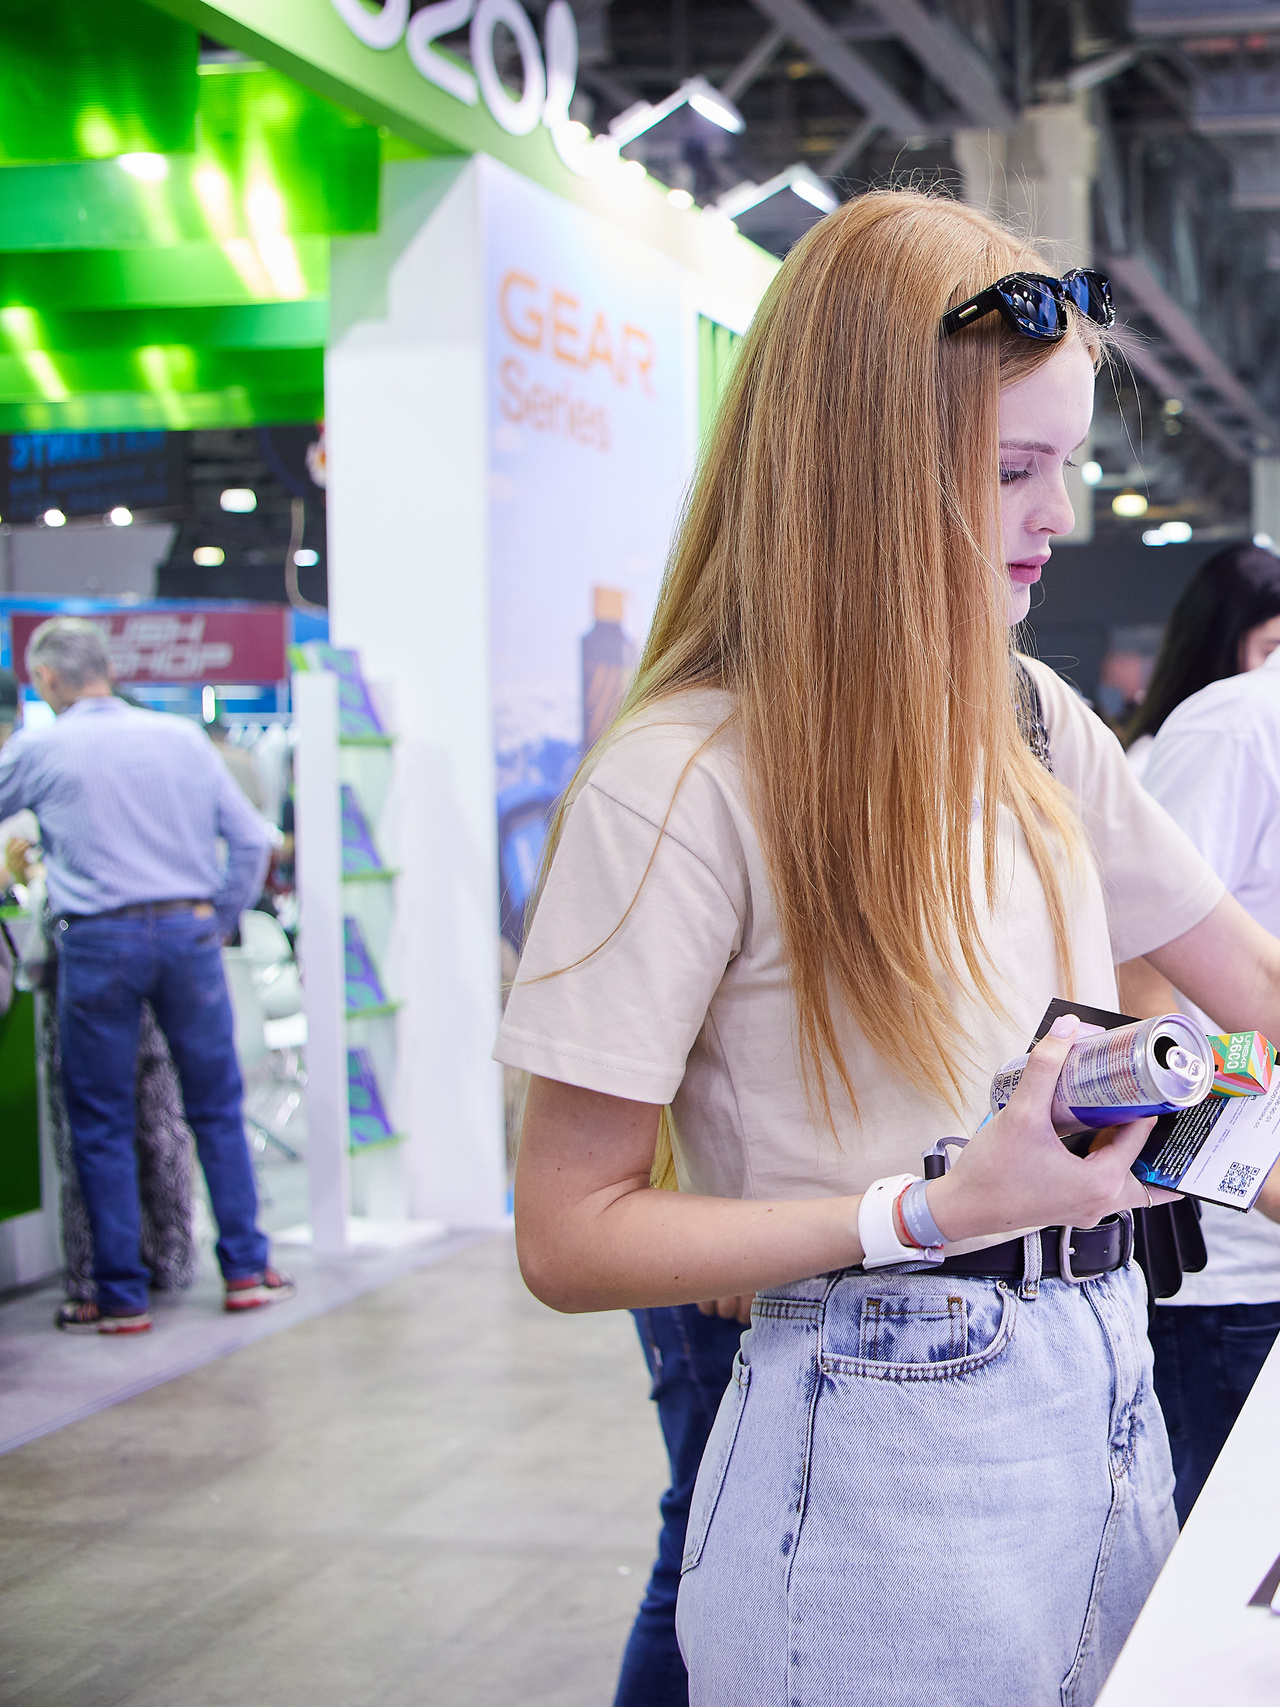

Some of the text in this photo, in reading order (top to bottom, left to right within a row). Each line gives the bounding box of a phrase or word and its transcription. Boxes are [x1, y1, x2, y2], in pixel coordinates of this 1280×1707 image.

[498, 271, 657, 397] GEAR
[499, 357, 611, 450] Series
[1226, 1034, 1243, 1069] 2600
[1239, 1034, 1251, 1068] LAISKA
[1011, 1069, 1020, 1086] 0,25
